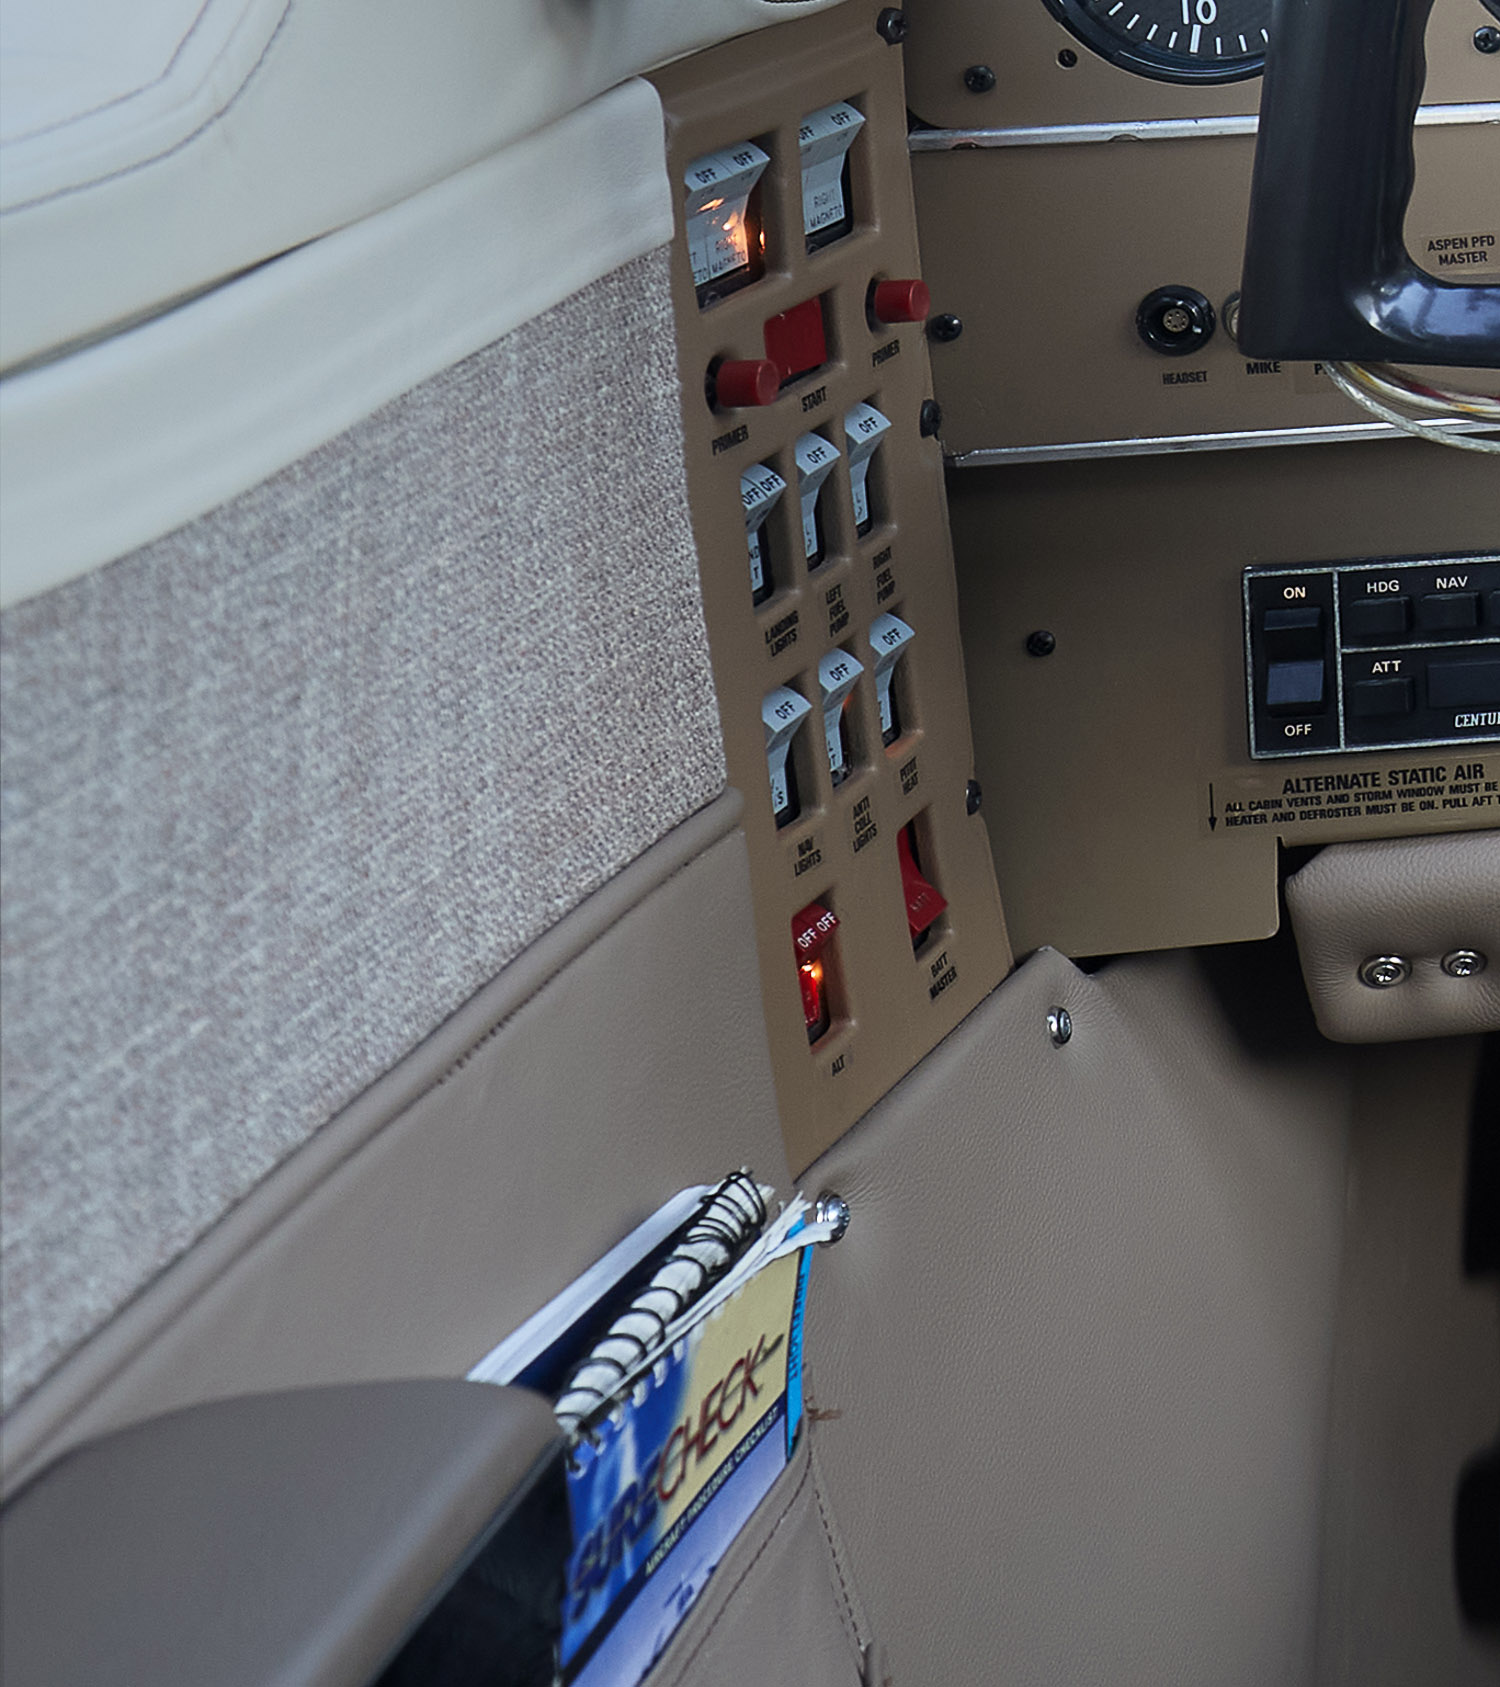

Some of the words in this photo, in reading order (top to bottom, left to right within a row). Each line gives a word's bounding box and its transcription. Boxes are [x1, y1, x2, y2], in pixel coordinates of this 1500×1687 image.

[1427, 237, 1469, 252] ASPEN
[1472, 236, 1495, 249] PFD
[1438, 251, 1488, 266] MASTER
[712, 424, 749, 455] PRIMER
[1436, 576, 1467, 589] NAV
[1282, 773, 1382, 795] ALTERNATE
[1388, 768, 1449, 788] STATIC
[1453, 763, 1484, 781] AIR
[930, 965, 957, 1000] MASTER
[655, 1333, 766, 1502] CHECK
